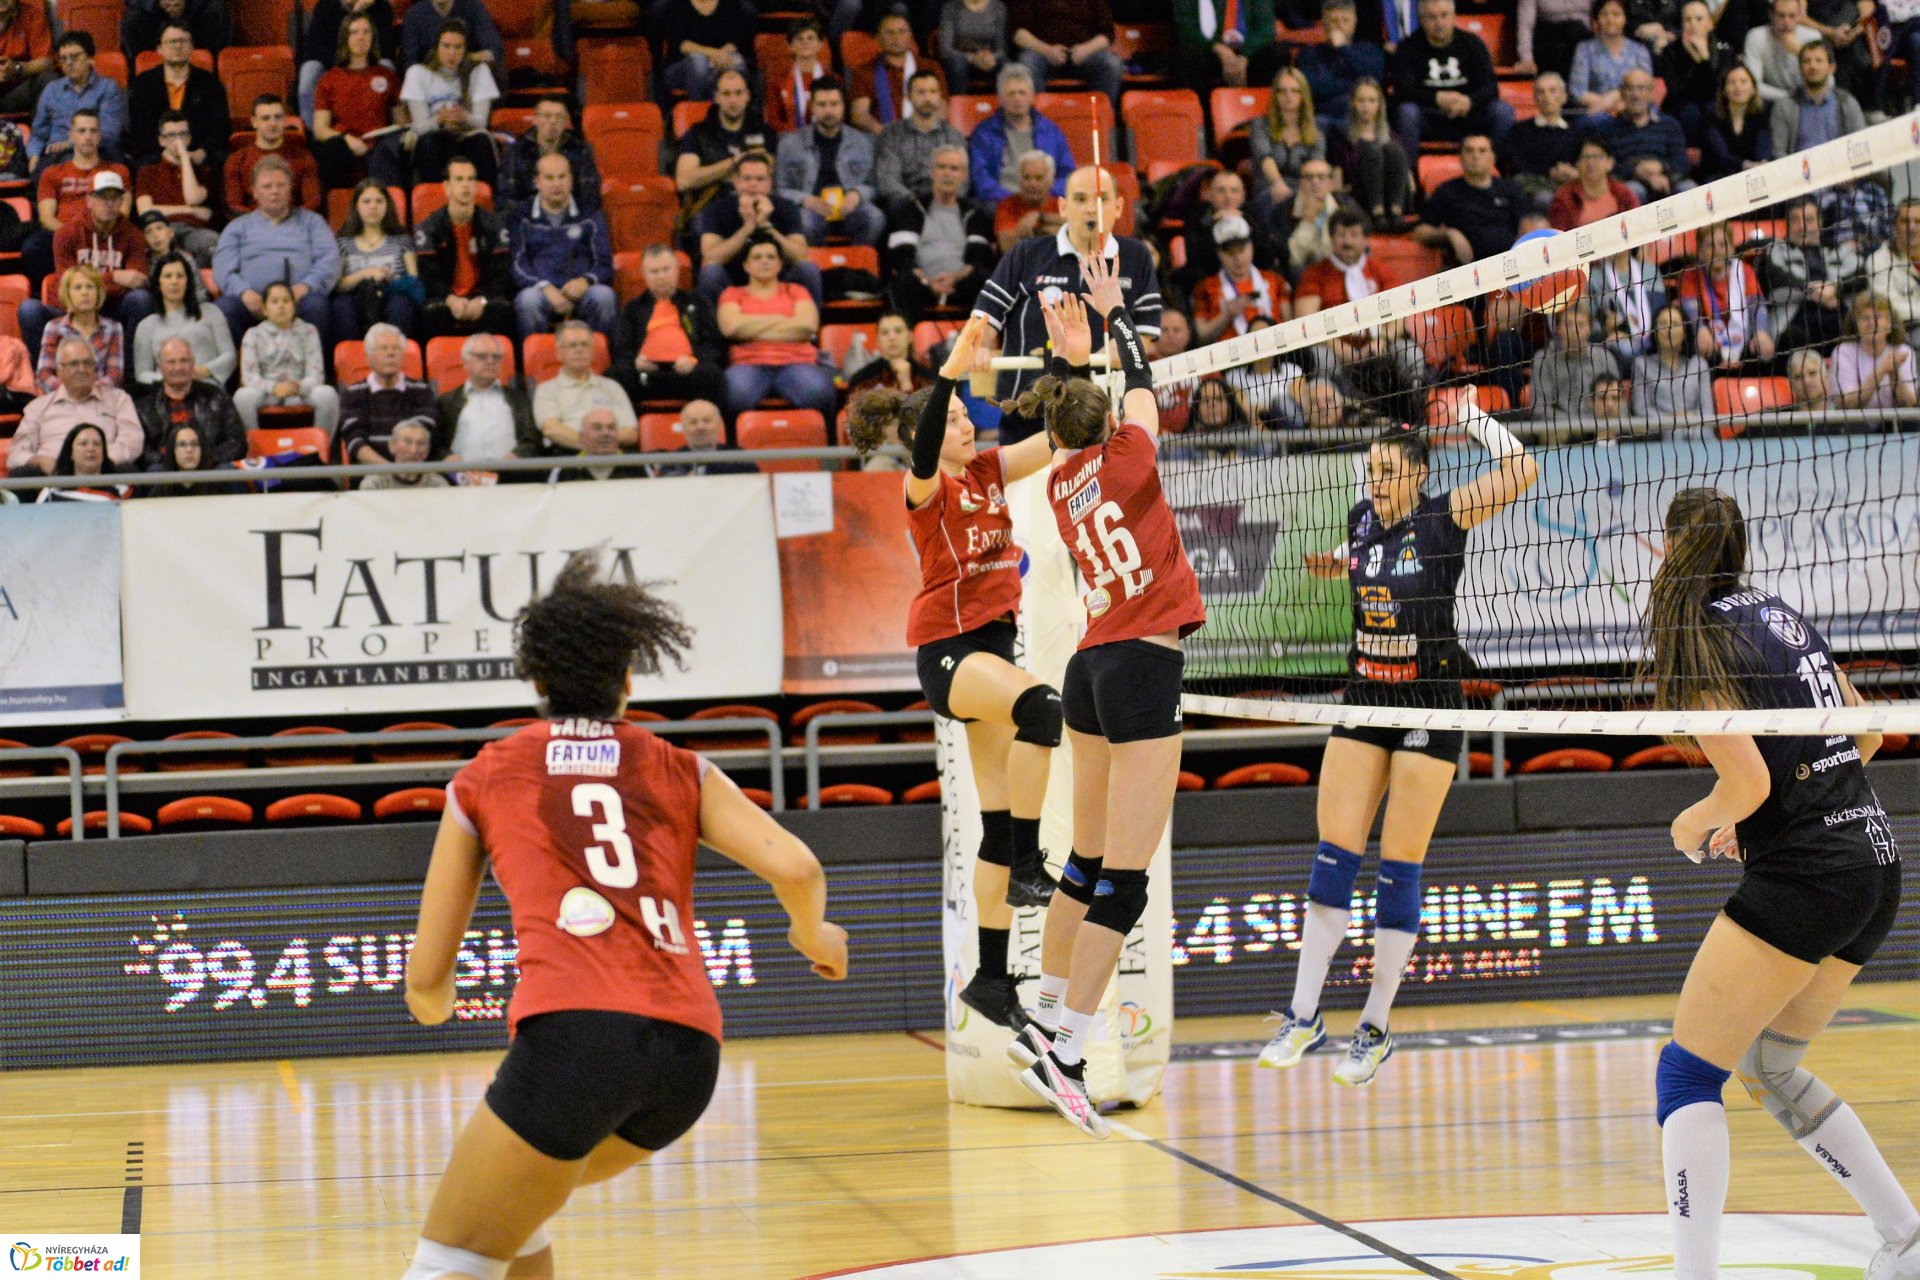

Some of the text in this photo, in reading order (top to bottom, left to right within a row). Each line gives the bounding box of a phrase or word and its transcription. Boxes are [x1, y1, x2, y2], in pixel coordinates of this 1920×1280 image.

[1070, 481, 1099, 515] FATUM
[1075, 501, 1142, 588] 16
[249, 517, 637, 632] FATU
[257, 627, 489, 661] PROPE
[253, 661, 515, 689] INGATLANBERUH
[941, 655, 955, 671] 2
[552, 744, 616, 763] FATUM
[571, 783, 638, 888] 3
[1547, 876, 1660, 948] FM
[1815, 1143, 1852, 1179] MIKASA
[1675, 1169, 1690, 1218] MIKASA
